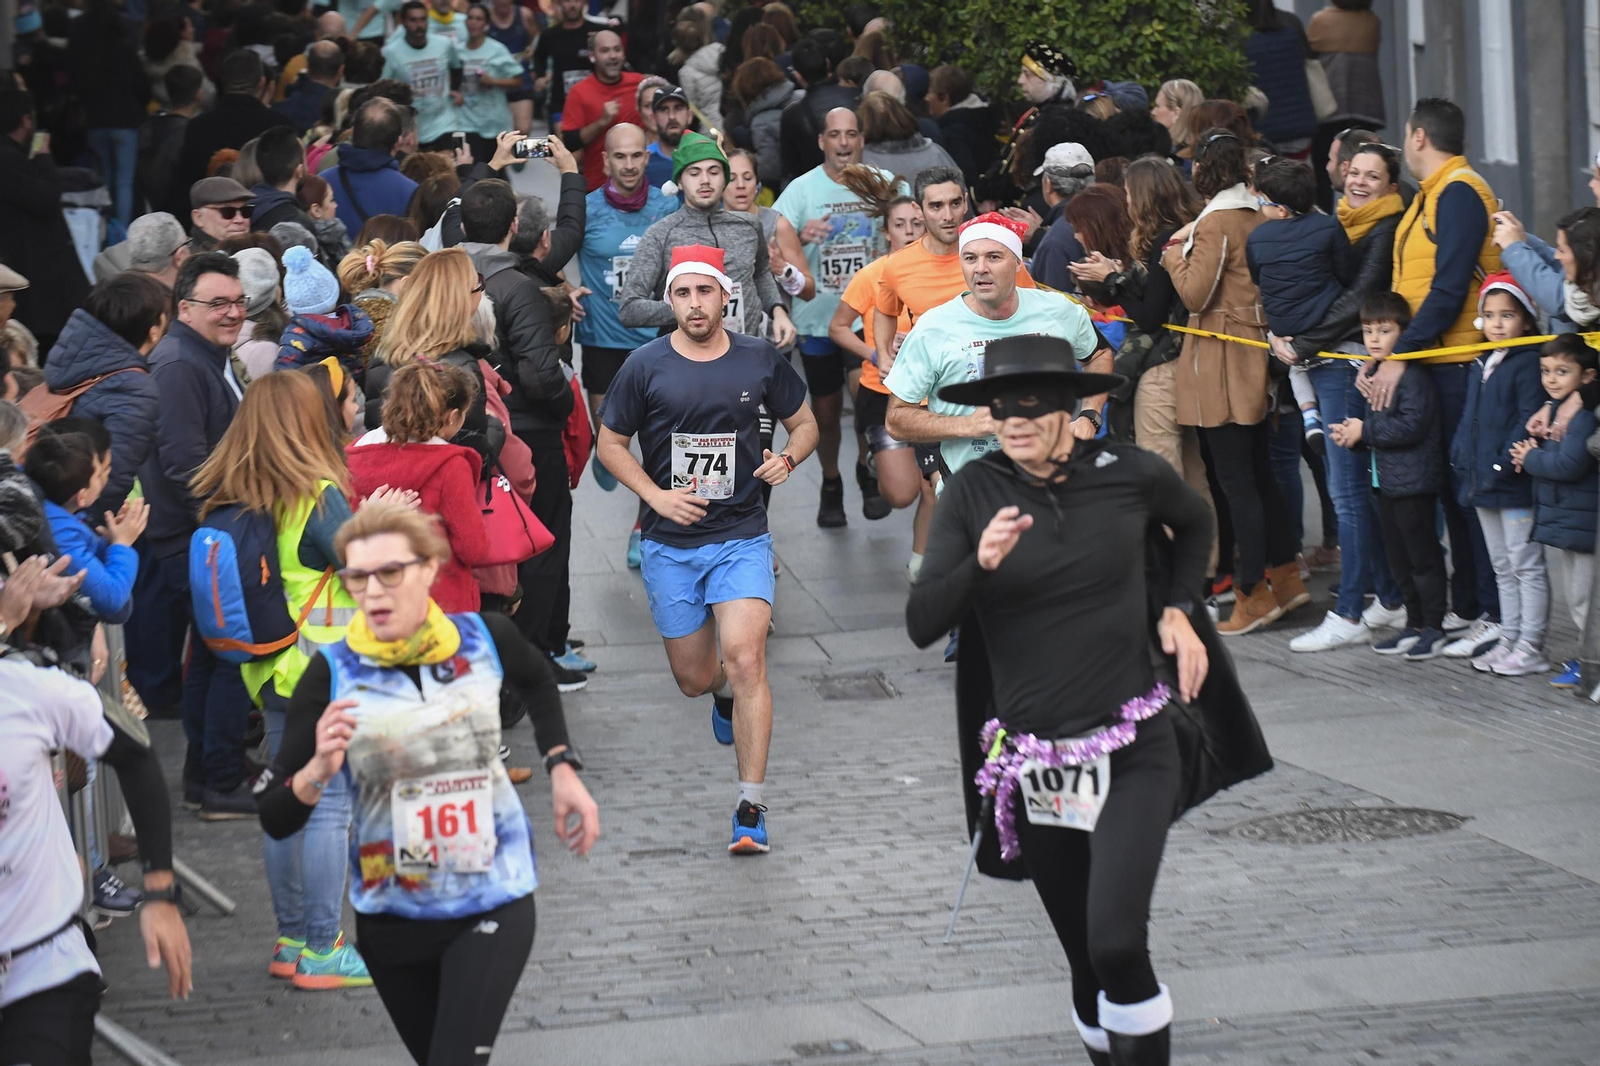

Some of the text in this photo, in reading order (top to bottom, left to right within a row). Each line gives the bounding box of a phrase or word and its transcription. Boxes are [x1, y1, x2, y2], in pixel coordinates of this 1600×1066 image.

[822, 257, 863, 276] 1575
[615, 271, 628, 287] 1
[684, 452, 728, 476] 774
[1023, 765, 1099, 795] 1071
[417, 800, 477, 840] 161
